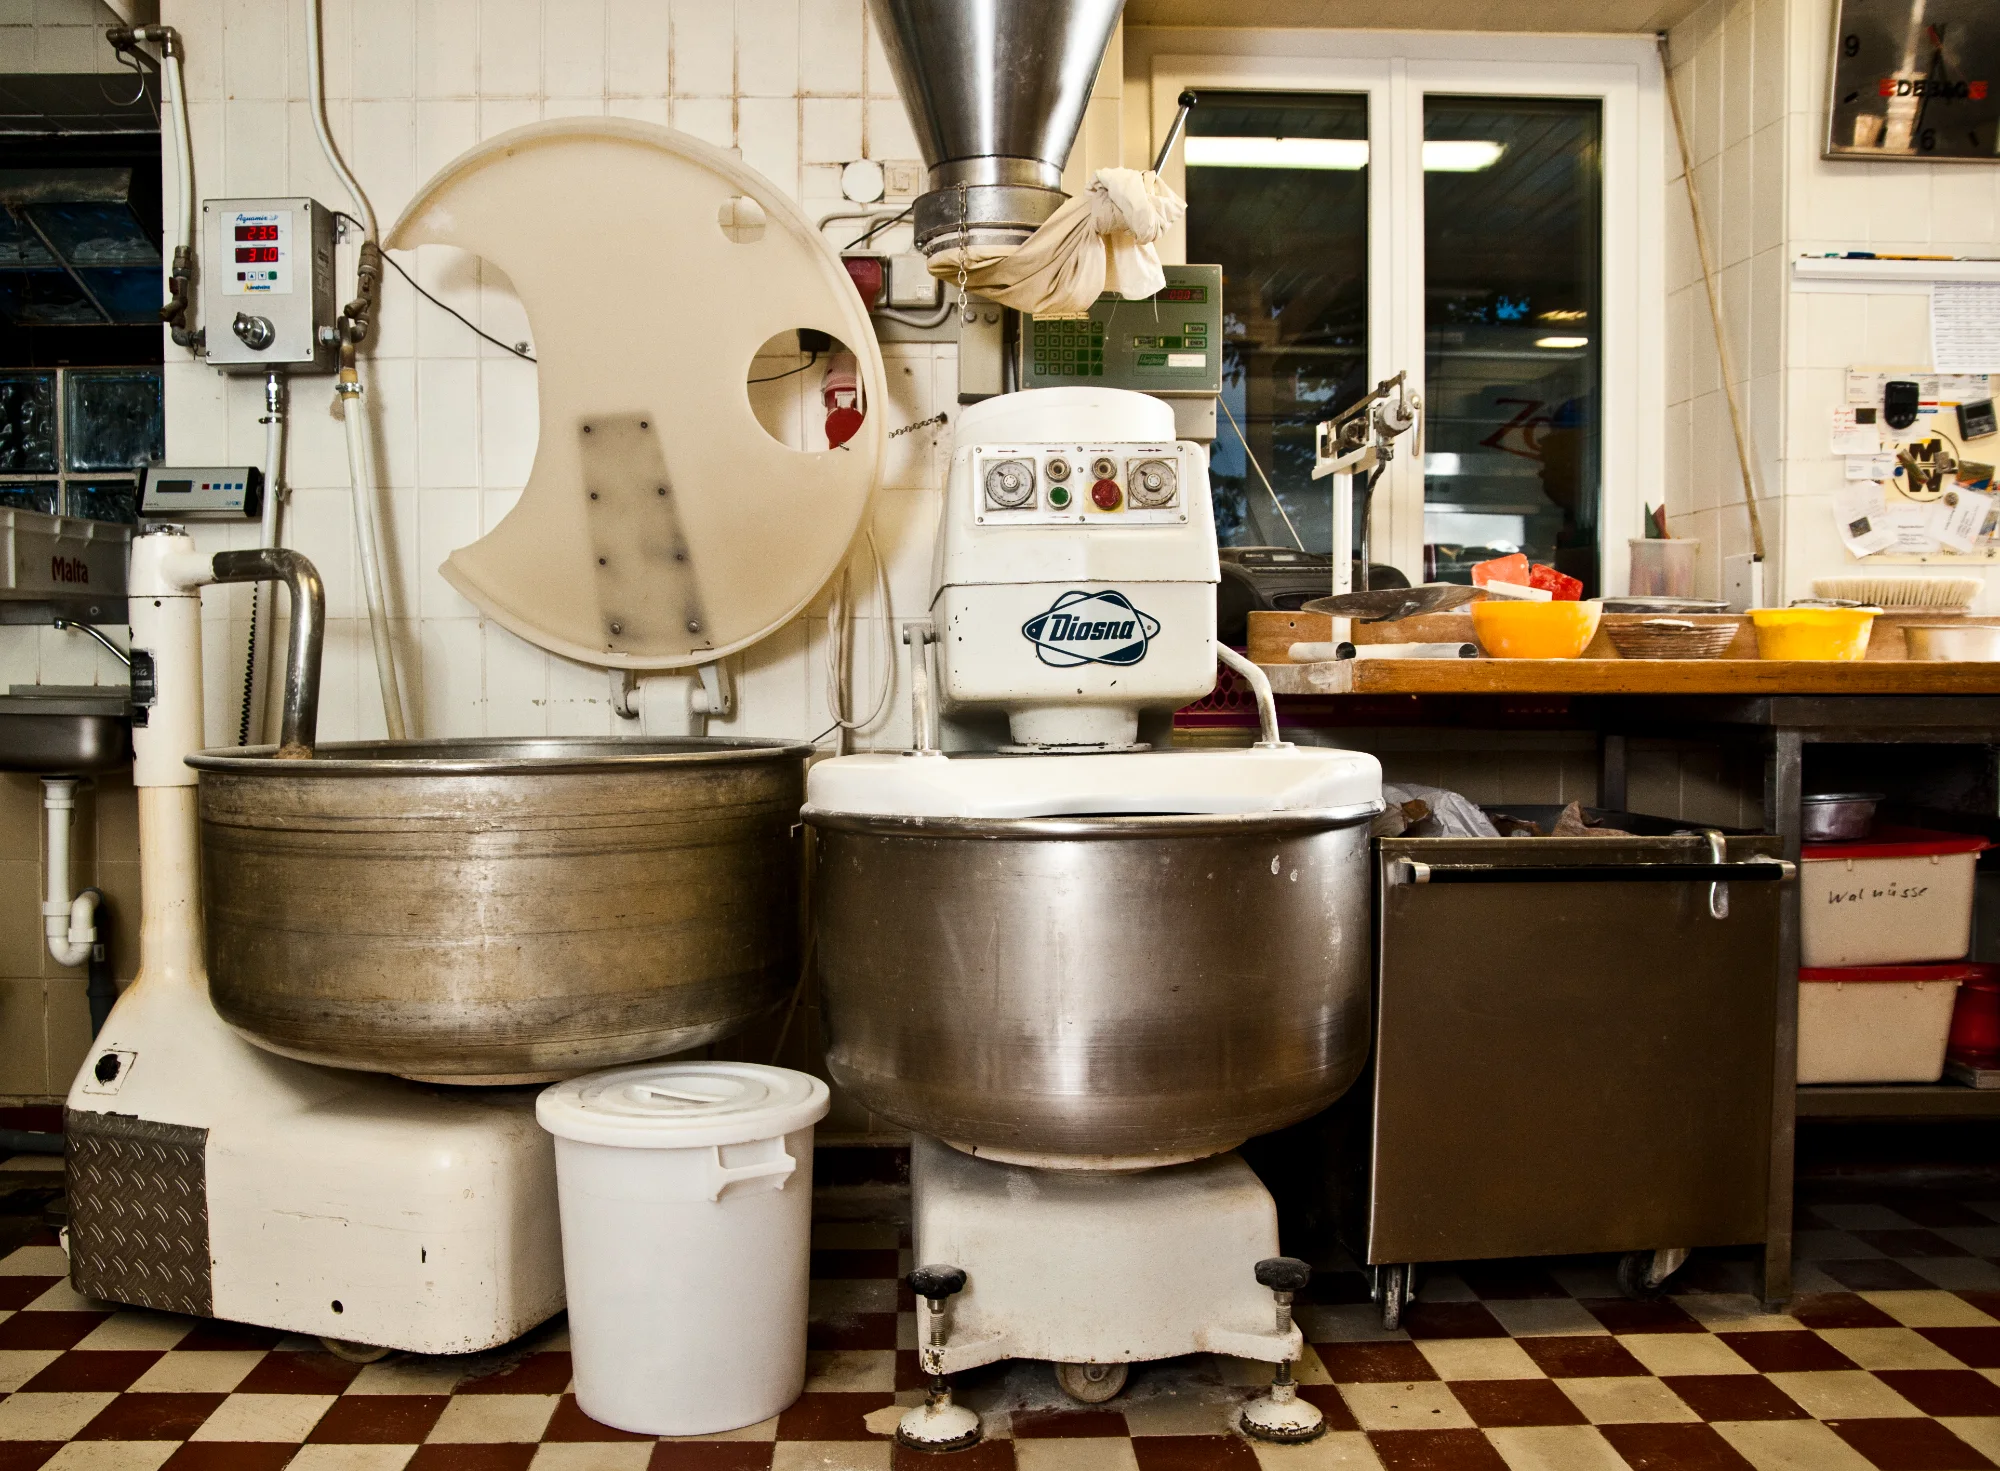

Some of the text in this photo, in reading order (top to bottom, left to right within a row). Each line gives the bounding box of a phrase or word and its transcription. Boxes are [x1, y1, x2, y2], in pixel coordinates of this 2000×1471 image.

[1844, 34, 1860, 57] 9
[1920, 128, 1936, 151] 6
[52, 556, 89, 584] Malta
[1048, 613, 1136, 642] Diosna
